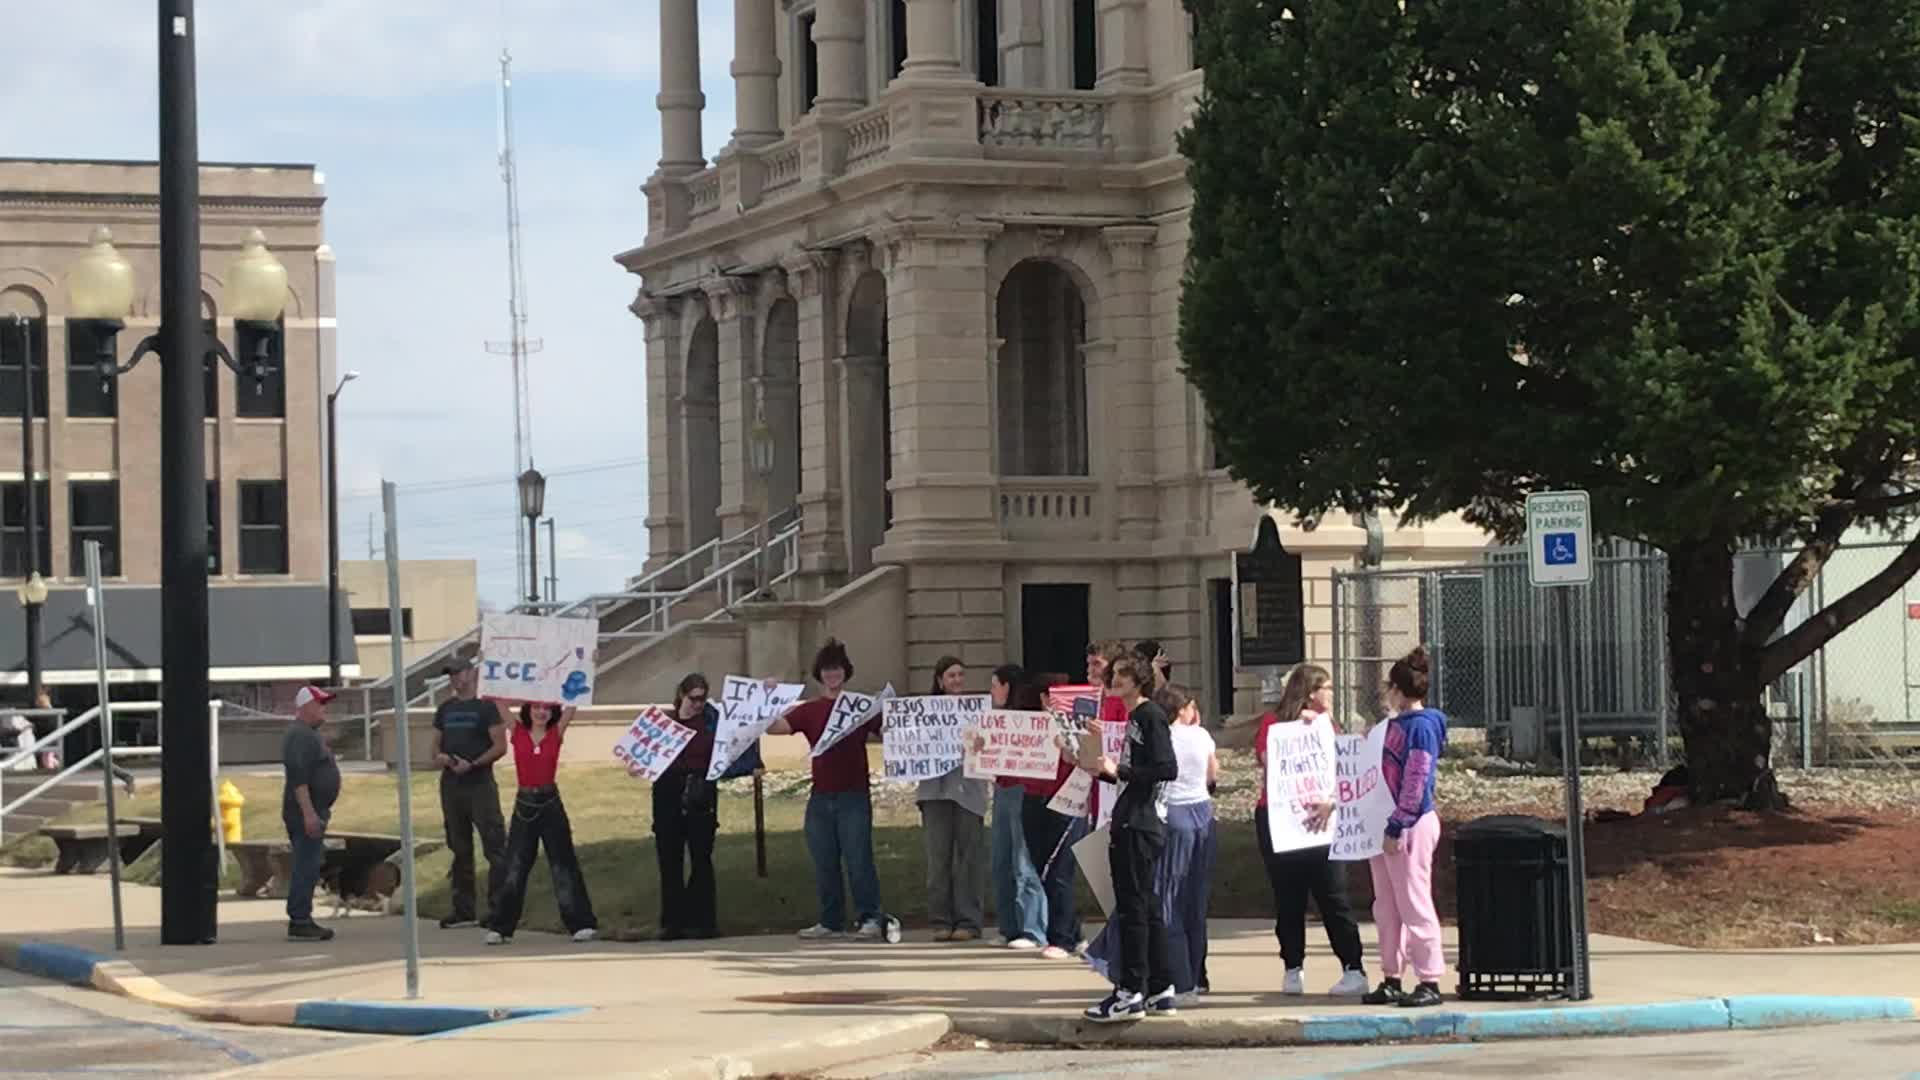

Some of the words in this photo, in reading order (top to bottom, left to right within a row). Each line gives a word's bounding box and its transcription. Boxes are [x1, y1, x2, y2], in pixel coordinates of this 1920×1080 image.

[1529, 500, 1585, 513] RESERVED
[1536, 517, 1583, 528] PARKING
[484, 661, 536, 682] ICE
[838, 694, 872, 712] NO
[886, 698, 925, 716] JESUS
[931, 699, 953, 712] DID
[958, 697, 984, 713] NOT
[645, 705, 693, 742] HATE
[887, 715, 912, 728] DIE
[915, 714, 940, 728] FOR
[942, 713, 958, 726] US
[981, 714, 1007, 730] LOVE
[1030, 716, 1050, 731] THY
[630, 726, 676, 758] MAKE
[889, 729, 920, 742] THAT
[631, 743, 658, 766] US
[888, 743, 931, 755] TREAT
[1335, 738, 1361, 756] WE
[885, 759, 907, 777] HOW
[1280, 751, 1328, 776] RIGHTS
[1336, 762, 1358, 777] ALL
[1339, 765, 1378, 803] BLEED
[1340, 806, 1360, 820] THE
[1337, 821, 1366, 838] SAME
